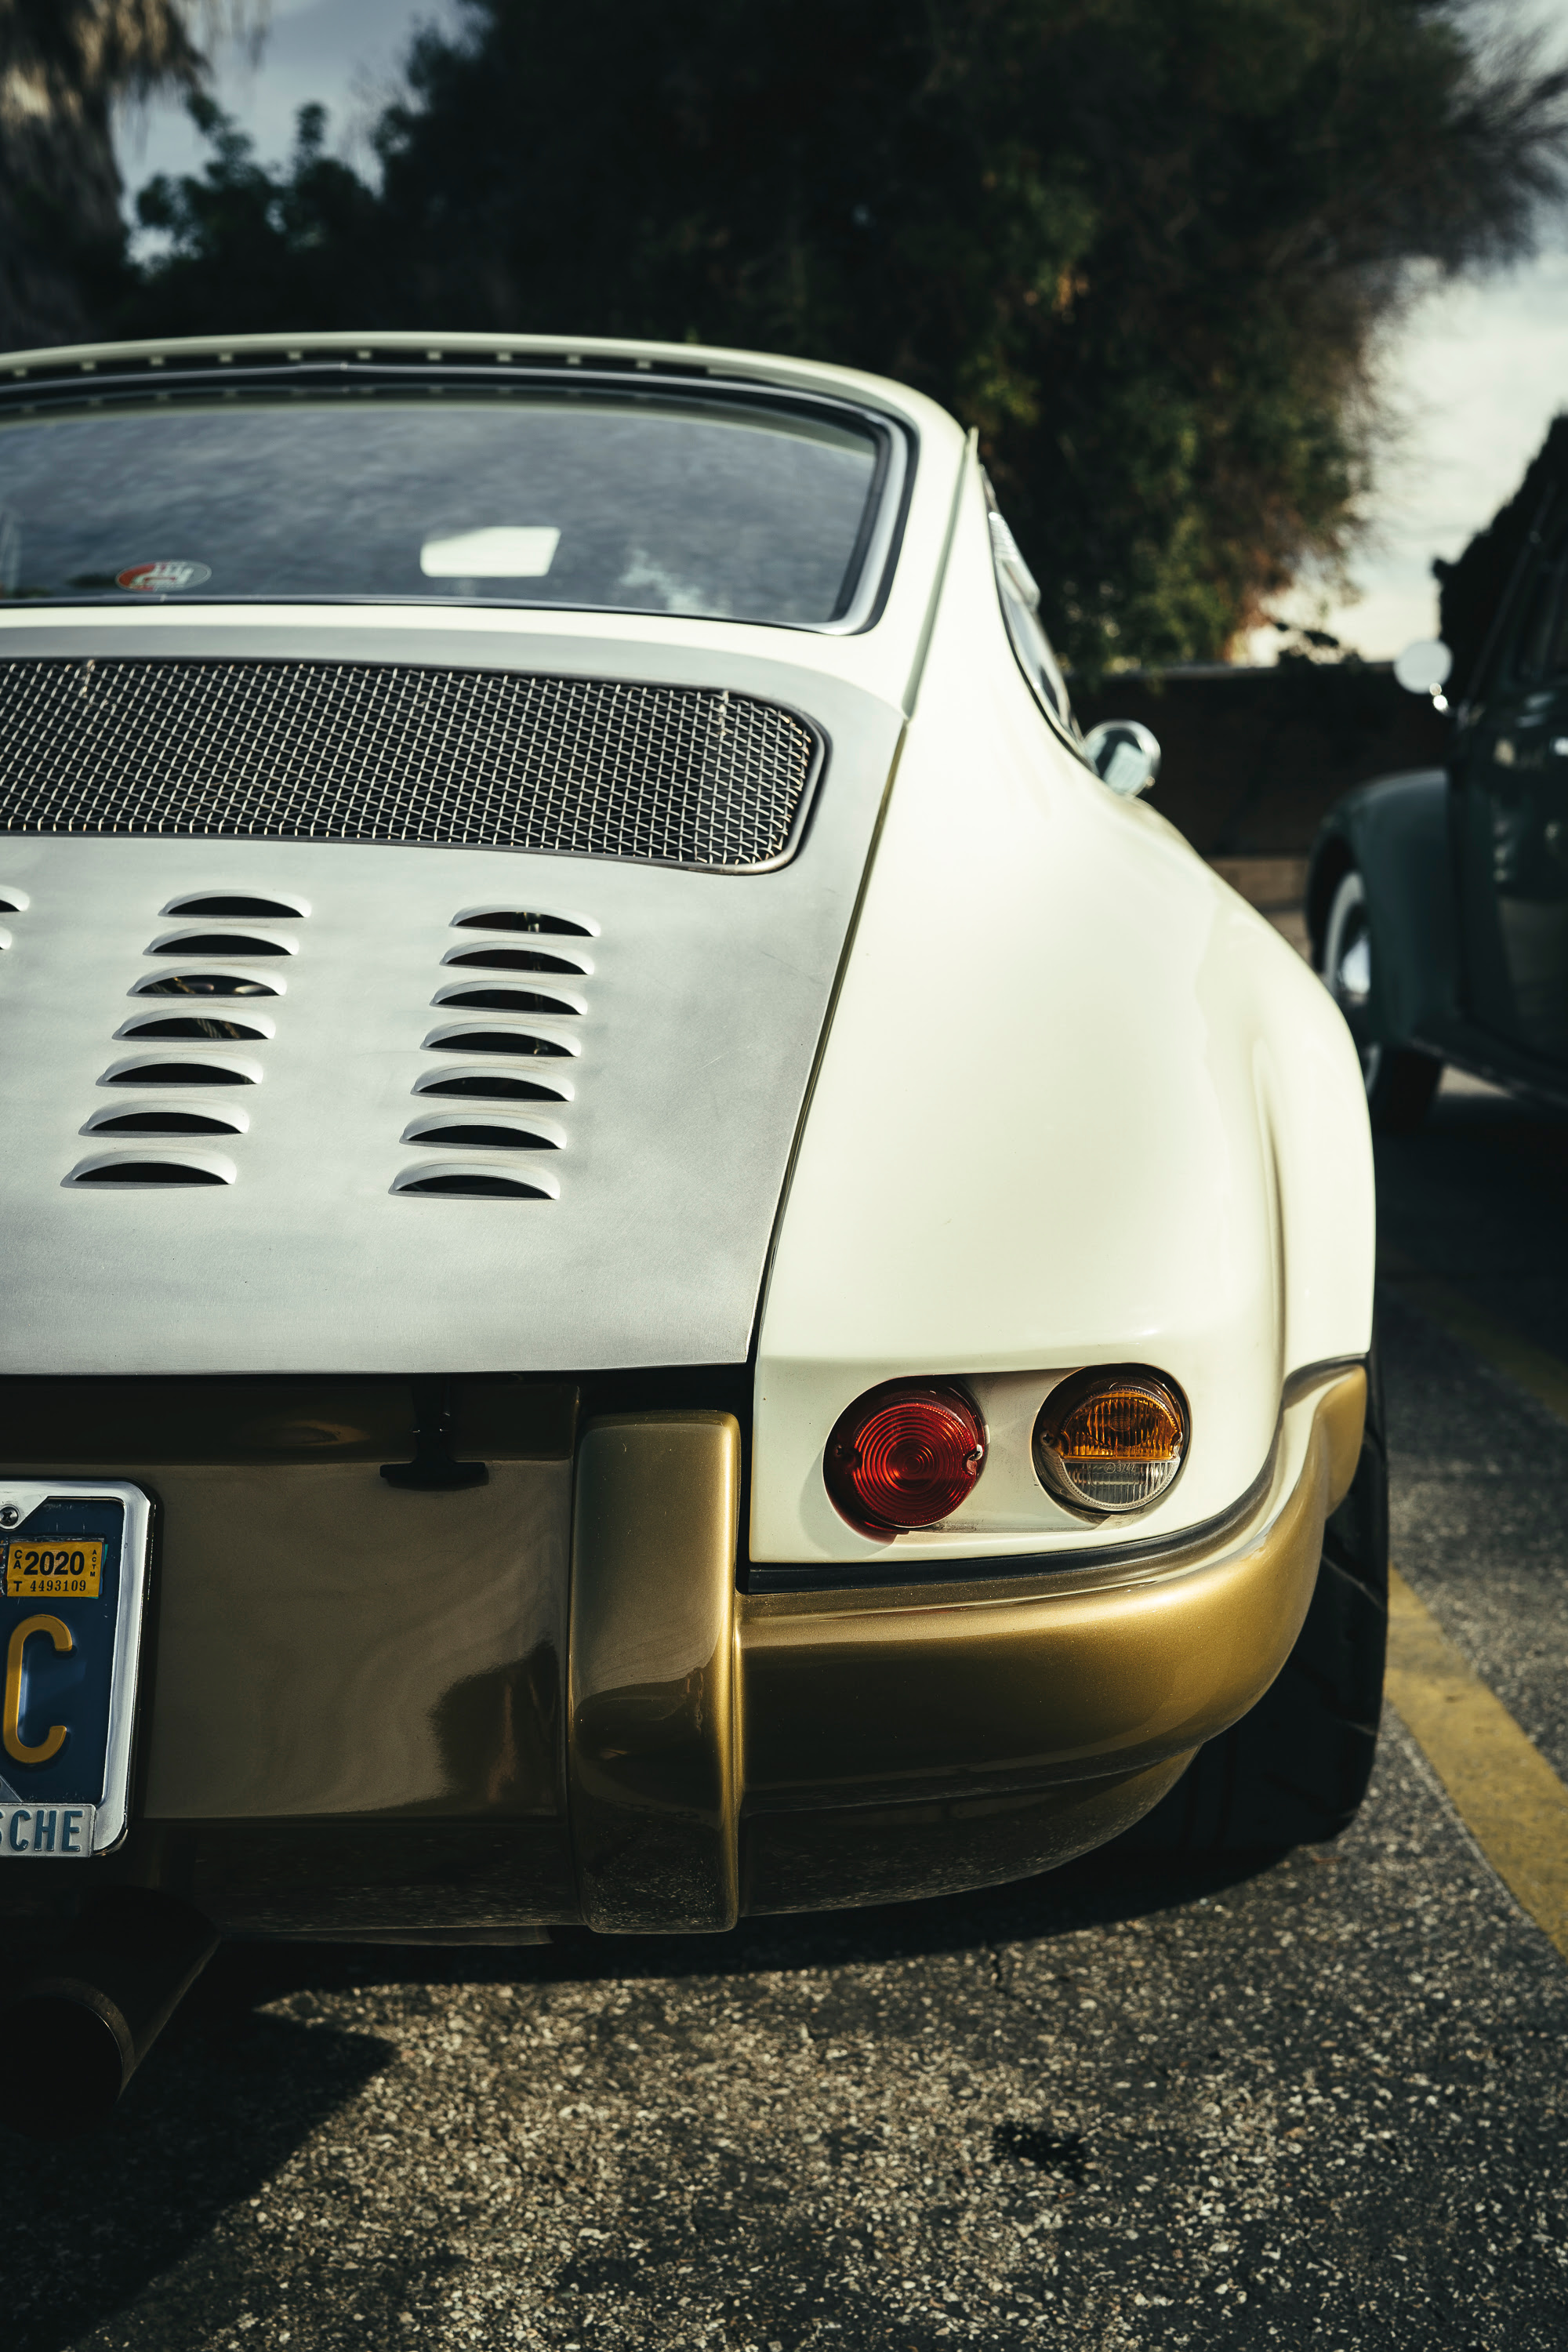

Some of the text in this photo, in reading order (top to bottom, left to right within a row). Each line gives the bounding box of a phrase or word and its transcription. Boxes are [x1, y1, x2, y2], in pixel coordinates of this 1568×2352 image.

[24, 1551, 85, 1576] 2020
[13, 1580, 86, 1592] T 4493109
[3, 1614, 73, 1763] C
[0, 1809, 83, 1852] CHE
